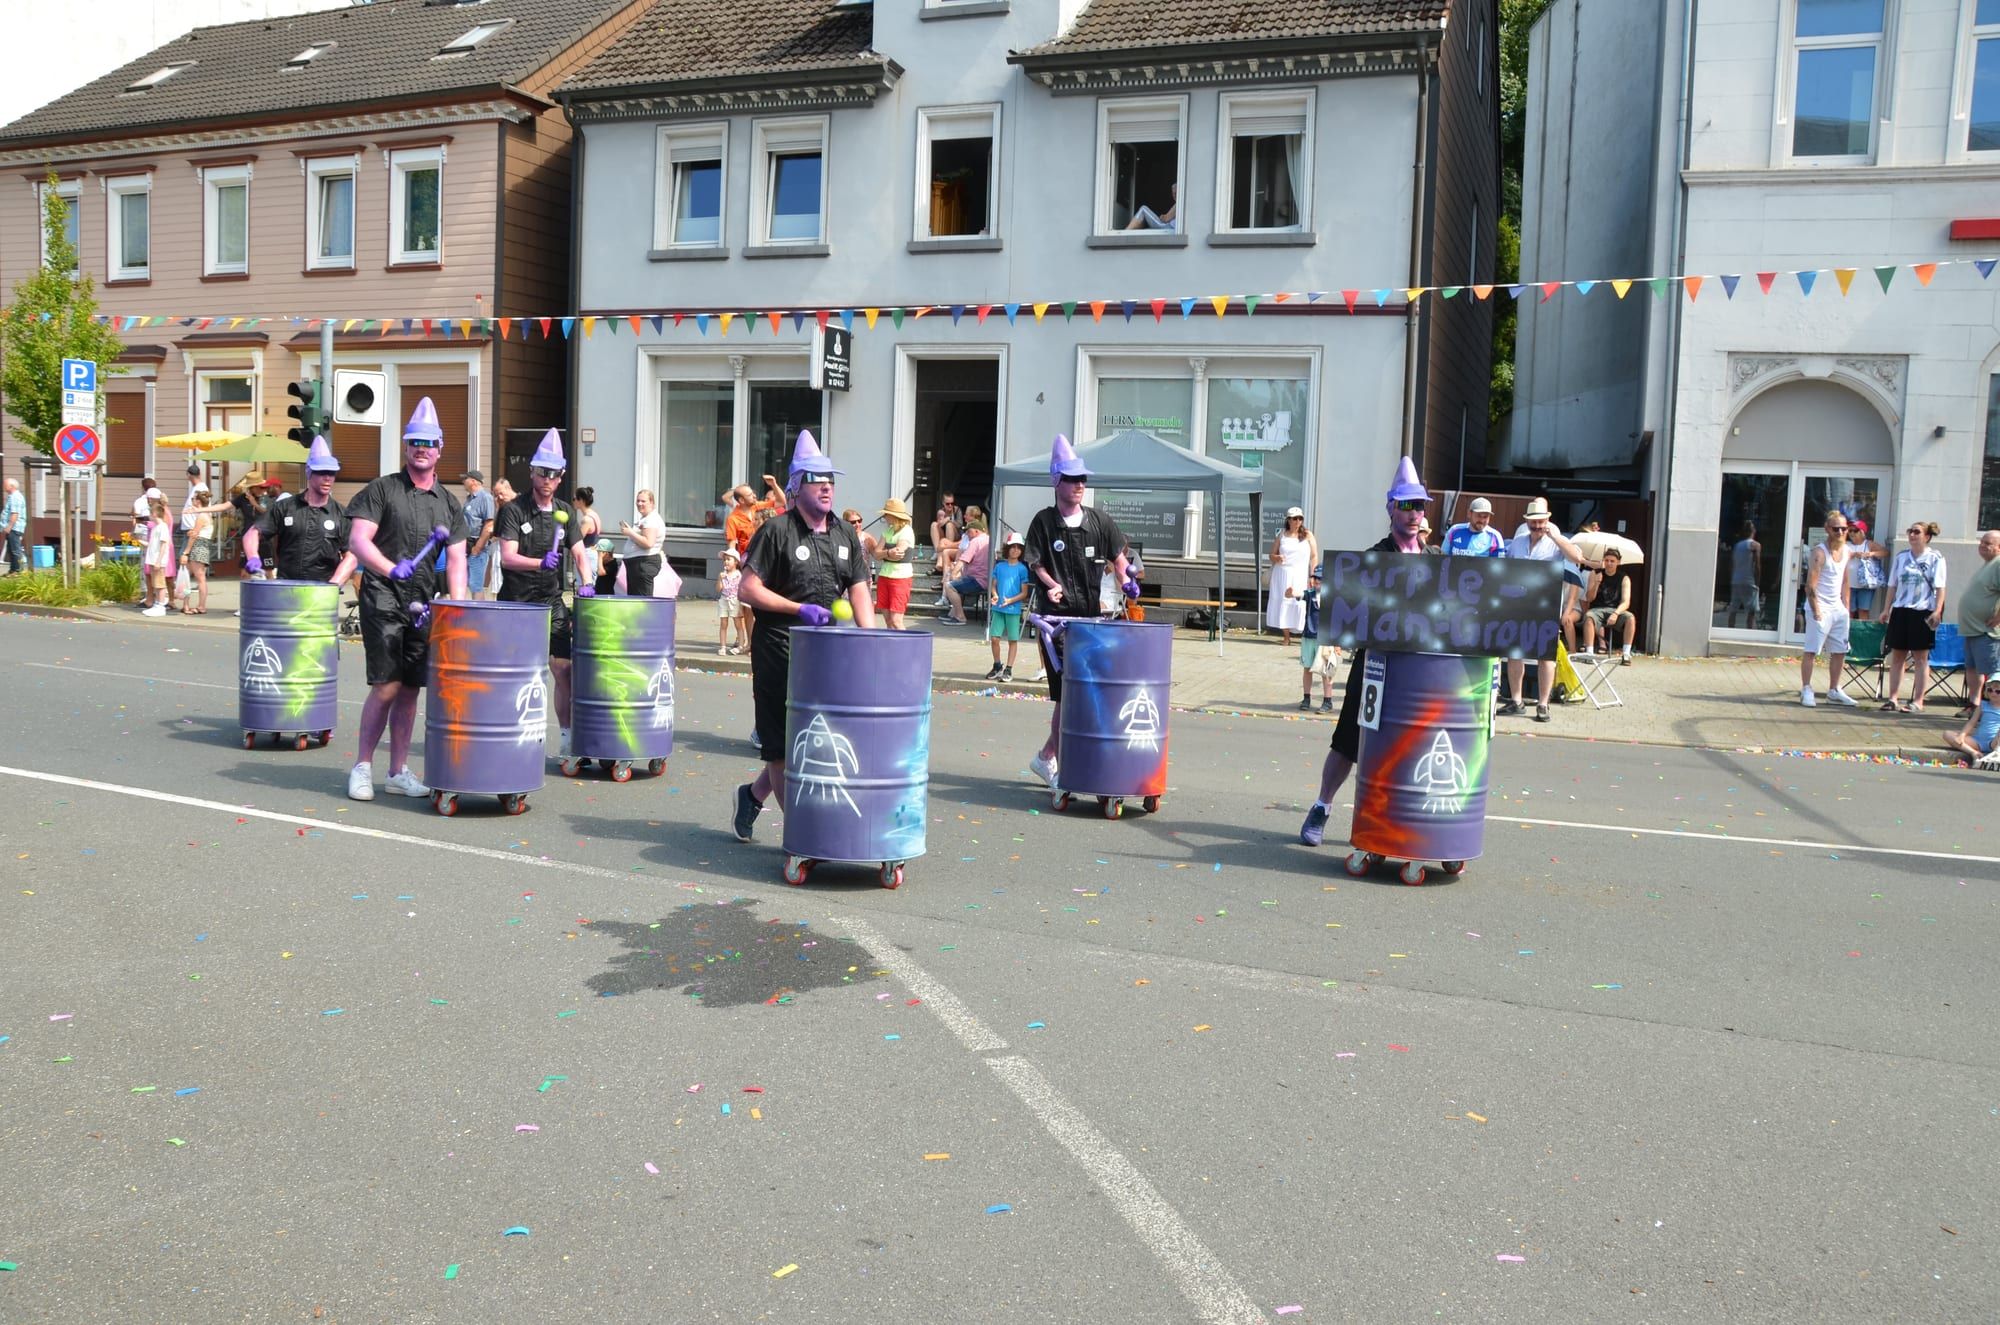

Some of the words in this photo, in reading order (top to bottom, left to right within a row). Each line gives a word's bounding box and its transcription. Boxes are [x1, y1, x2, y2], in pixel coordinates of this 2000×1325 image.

[70, 363, 89, 387] P
[1036, 391, 1045, 406] 4
[1334, 552, 1483, 604] Purple
[1330, 597, 1559, 657] Man-Group
[1364, 684, 1378, 723] 8
